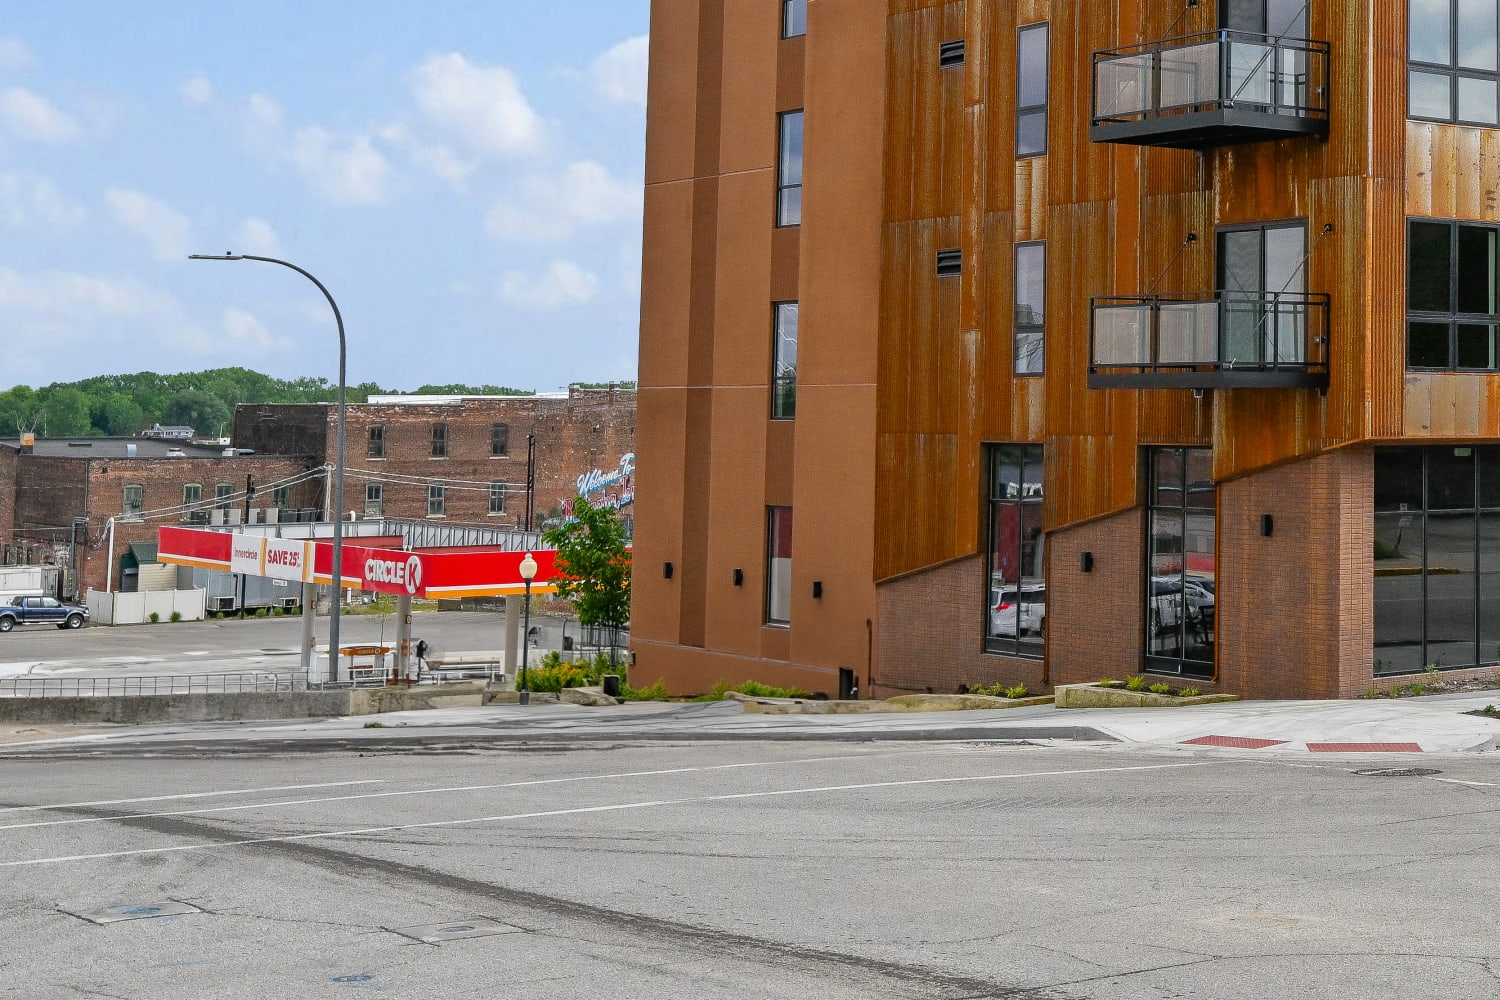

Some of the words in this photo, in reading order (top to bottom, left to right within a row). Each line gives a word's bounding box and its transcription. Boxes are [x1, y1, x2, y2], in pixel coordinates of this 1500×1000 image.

[577, 469, 622, 497] Welcome
[620, 453, 635, 477] To
[267, 549, 288, 566] SAVE
[365, 559, 405, 584] CIRCLE
[407, 560, 420, 593] K
